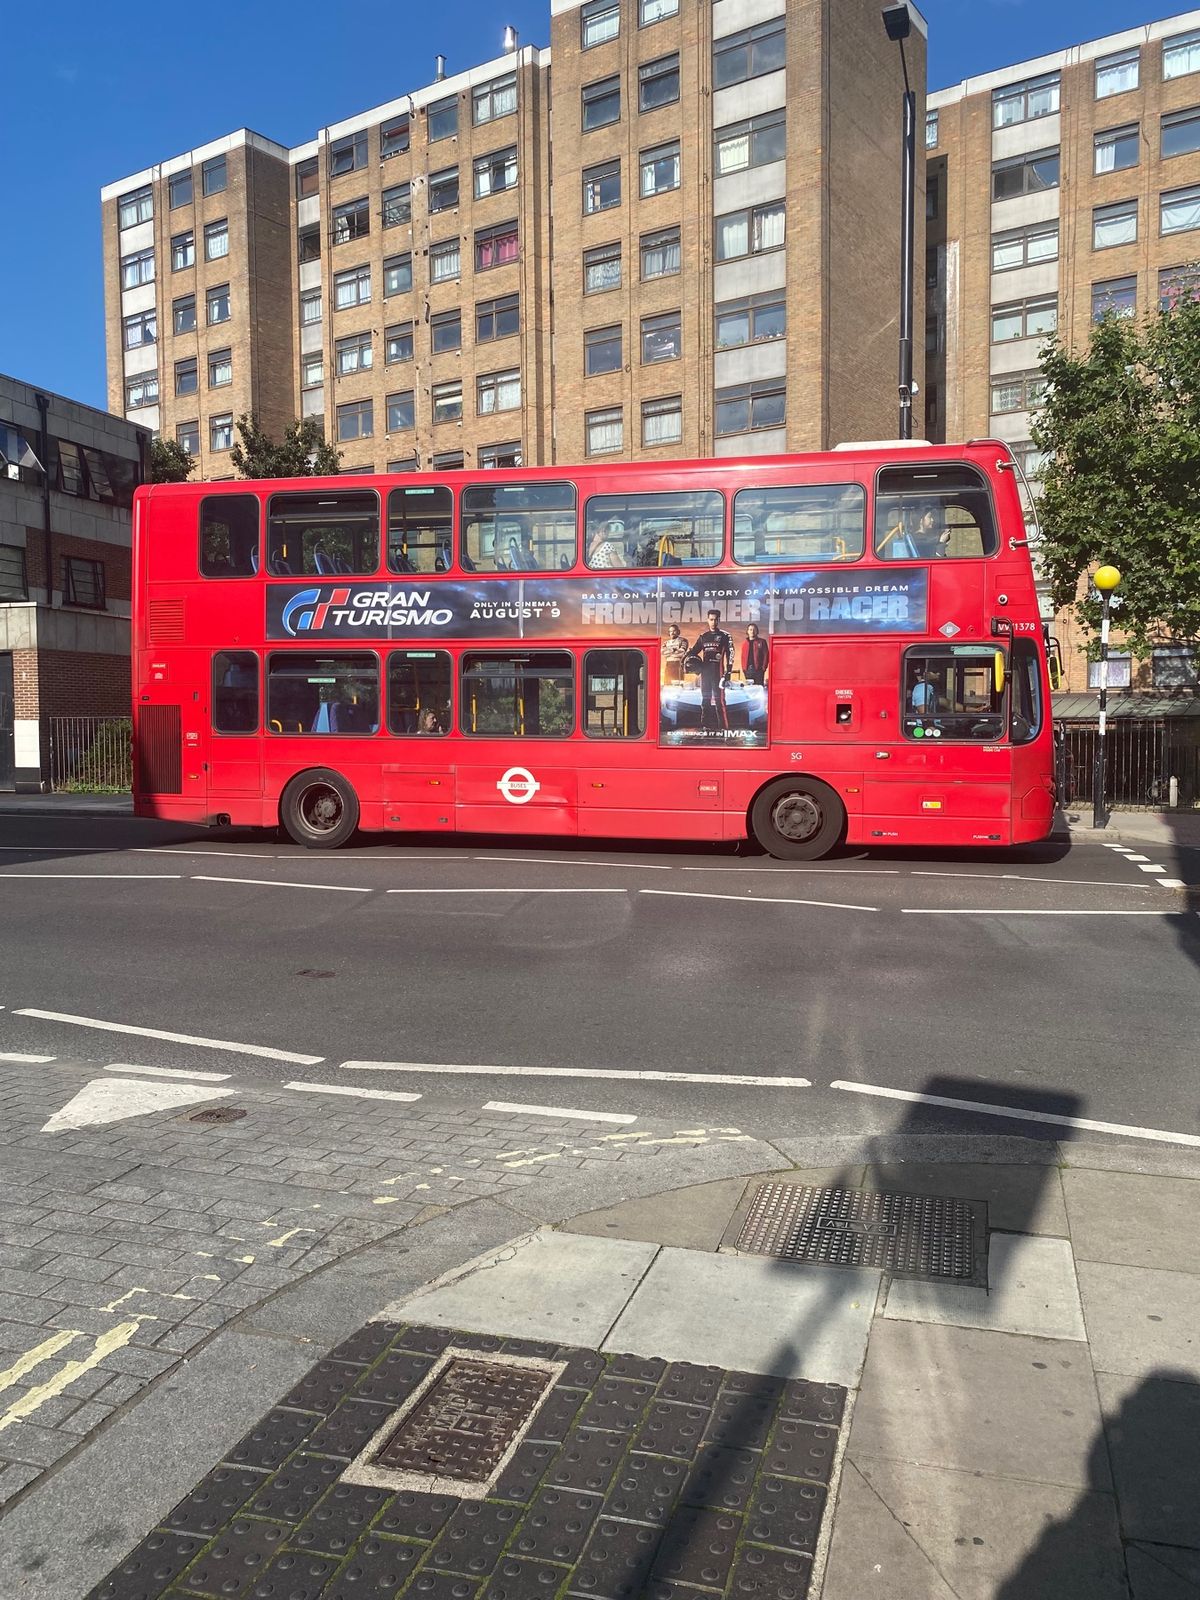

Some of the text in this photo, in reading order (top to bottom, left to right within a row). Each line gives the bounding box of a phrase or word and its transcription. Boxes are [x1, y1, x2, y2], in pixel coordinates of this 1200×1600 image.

[785, 586, 860, 595] IMPOSSIBLE
[865, 585, 909, 593] DREAM
[352, 591, 431, 608] GRAN
[514, 600, 558, 608] CINEMAS
[469, 608, 561, 619] AUGUST 9
[581, 595, 909, 625] FROM GAMER TO RACER
[332, 608, 453, 626] TURISMO
[724, 729, 758, 738] IMAX
[791, 752, 803, 760] SG
